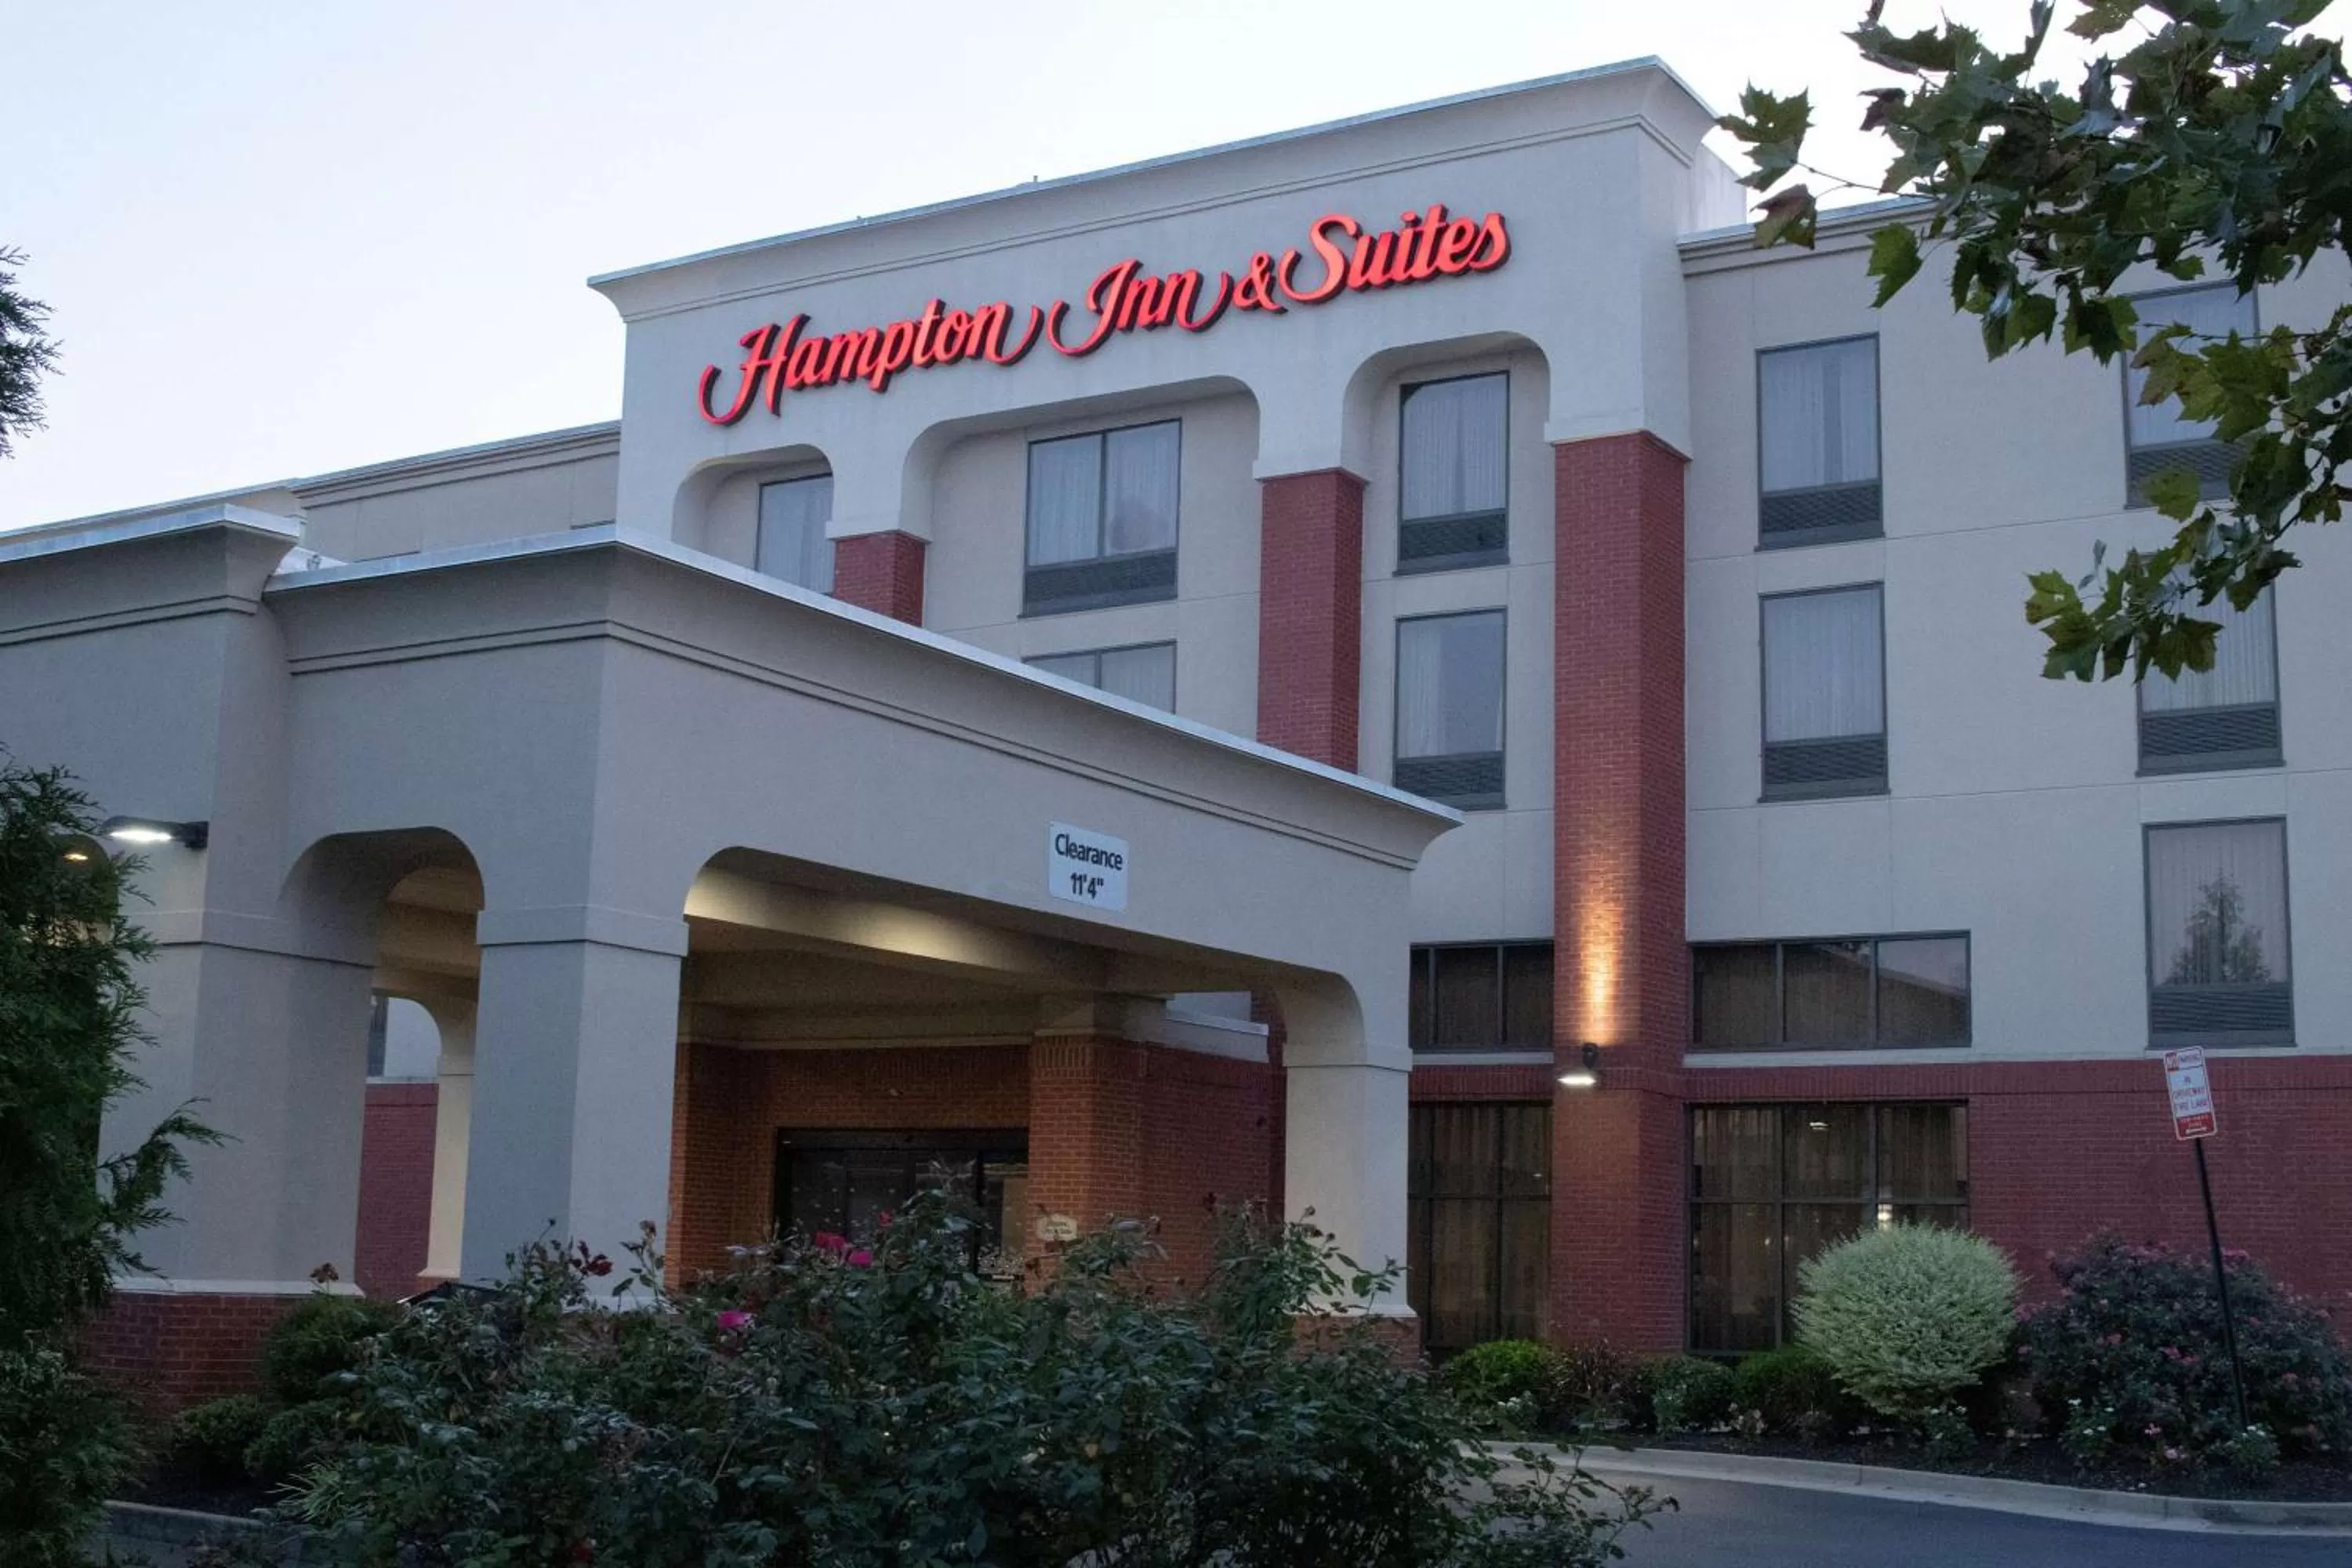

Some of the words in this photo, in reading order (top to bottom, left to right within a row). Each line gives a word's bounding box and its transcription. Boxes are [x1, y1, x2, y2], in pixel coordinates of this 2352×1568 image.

[698, 299, 1044, 426] Hampton
[1046, 259, 1235, 356] Inn
[1232, 250, 1288, 314] &
[1278, 203, 1512, 304] Suites
[1054, 833, 1123, 871] Clearance
